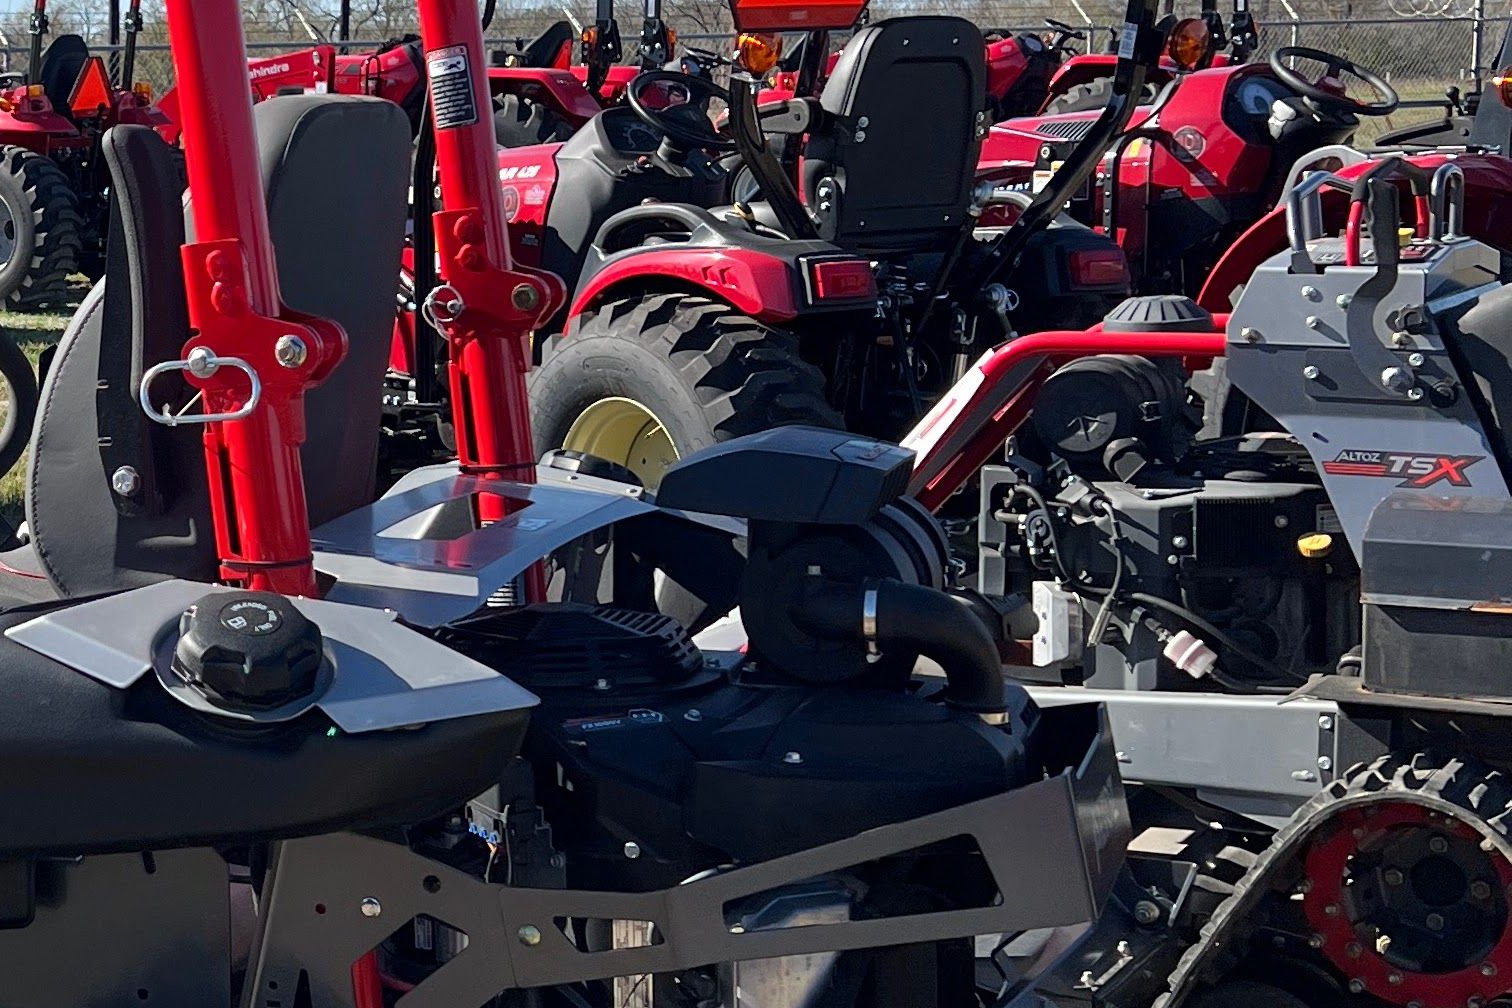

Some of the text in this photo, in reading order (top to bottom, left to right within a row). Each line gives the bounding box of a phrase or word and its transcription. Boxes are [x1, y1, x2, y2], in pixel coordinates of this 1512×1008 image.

[248, 63, 290, 80] ahindra
[1336, 451, 1467, 485] ALTOZ TSX
